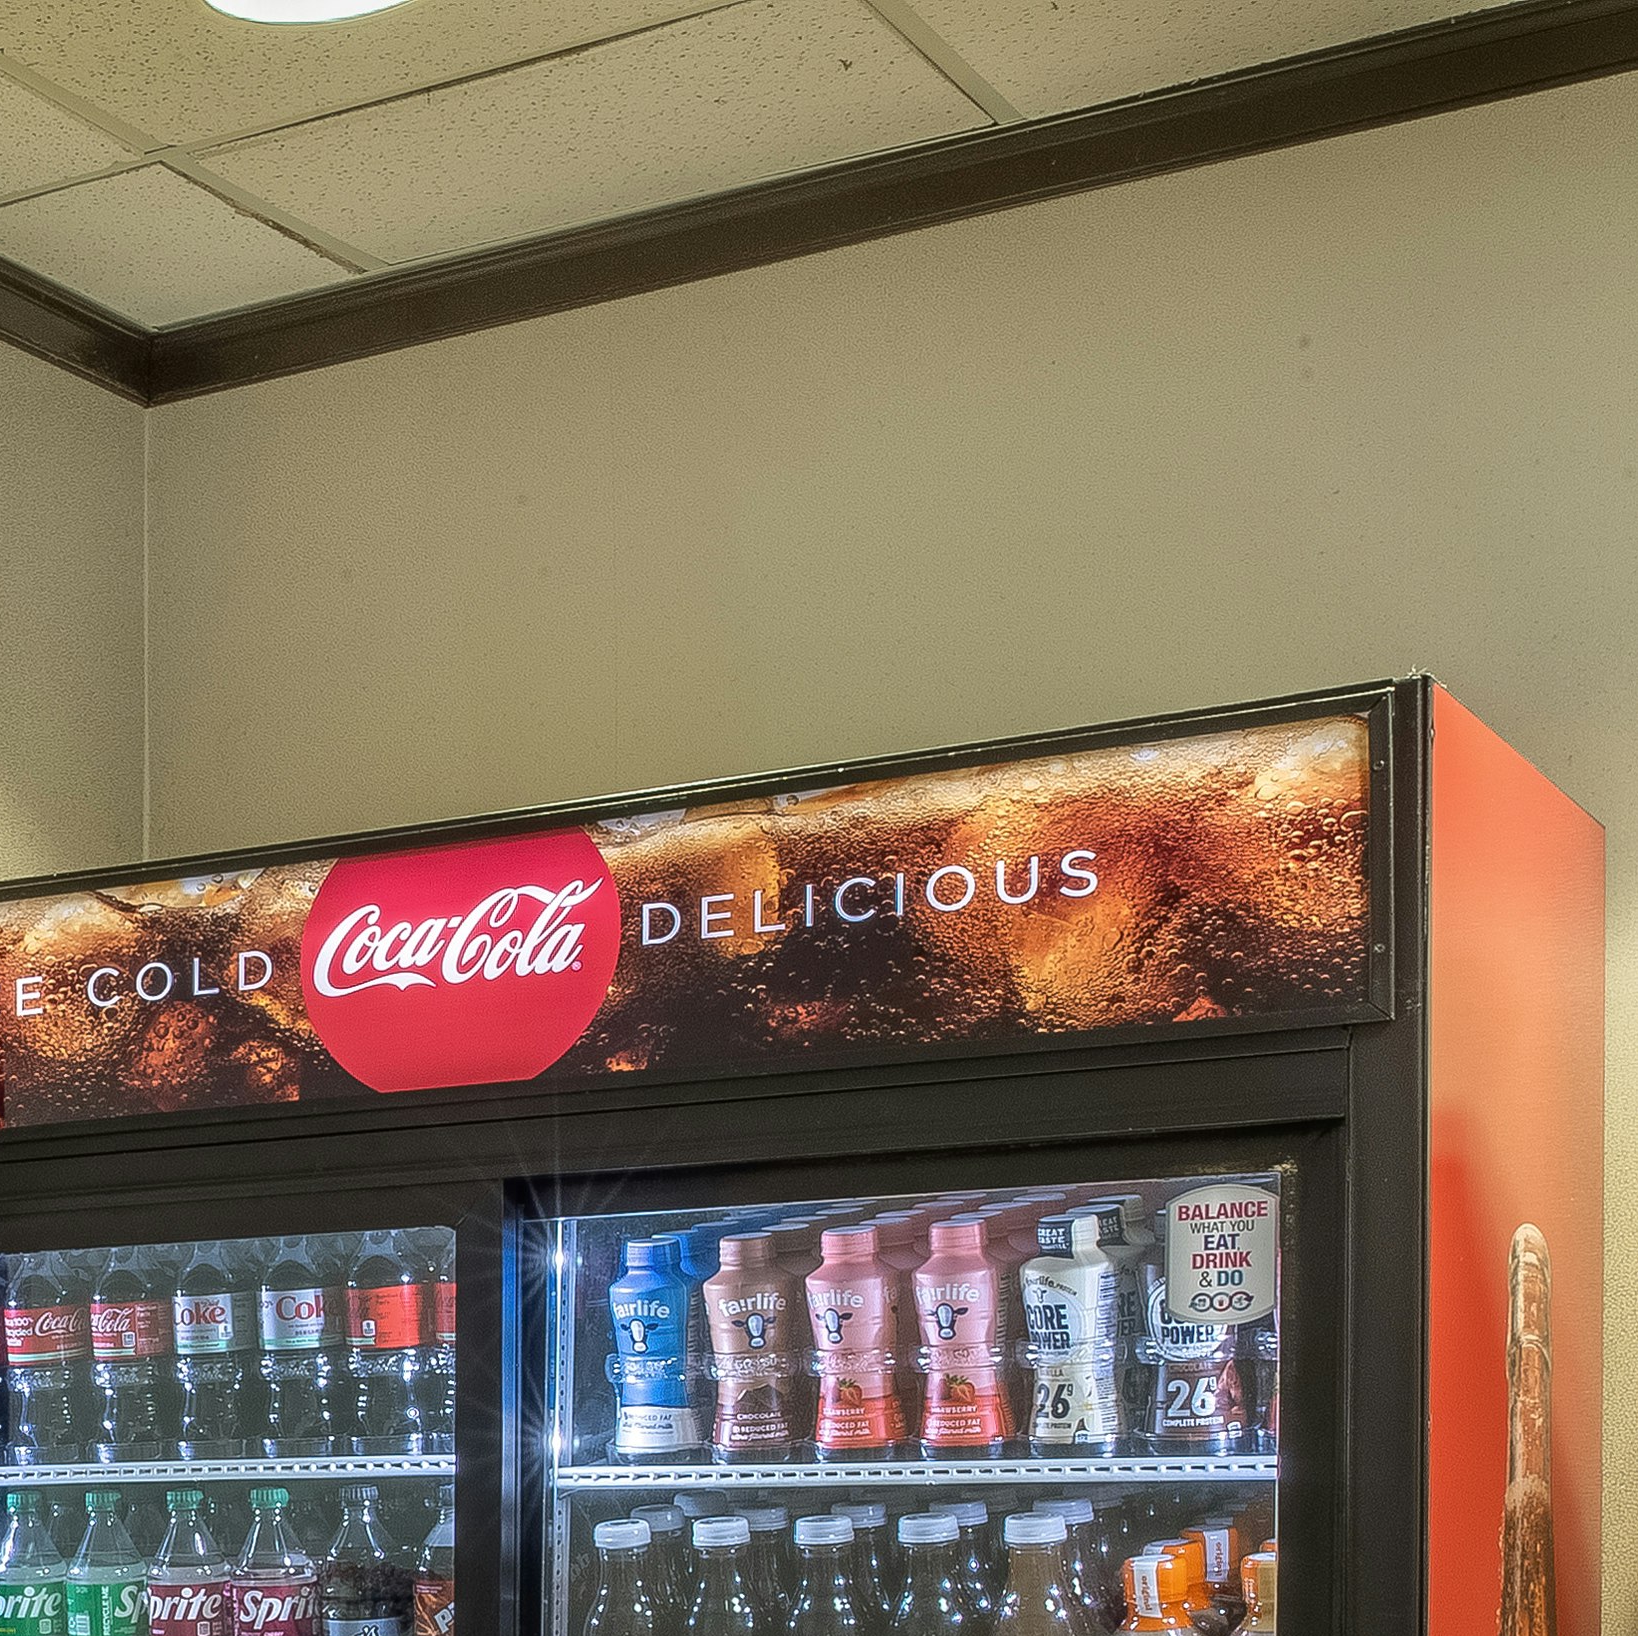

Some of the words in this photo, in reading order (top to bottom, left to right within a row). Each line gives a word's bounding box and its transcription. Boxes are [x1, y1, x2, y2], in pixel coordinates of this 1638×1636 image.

[640, 848, 1100, 946] DELICIOUS
[312, 877, 601, 999] Coca-Cola
[87, 950, 274, 1008] COLD
[1177, 1200, 1270, 1222] BALANCE
[1190, 1221, 1225, 1235] WHAT
[1230, 1219, 1255, 1233] YOU
[1192, 1250, 1253, 1271] DRINK
[1199, 1271, 1213, 1288] &
[1217, 1269, 1244, 1287] DO
[612, 1298, 671, 1321] fairlife
[718, 1291, 787, 1320] fairlife
[1027, 1303, 1069, 1331] CORE
[102, 1585, 110, 1600] ME
[102, 1601, 111, 1636] RECYCLE
[148, 1586, 222, 1631] prite
